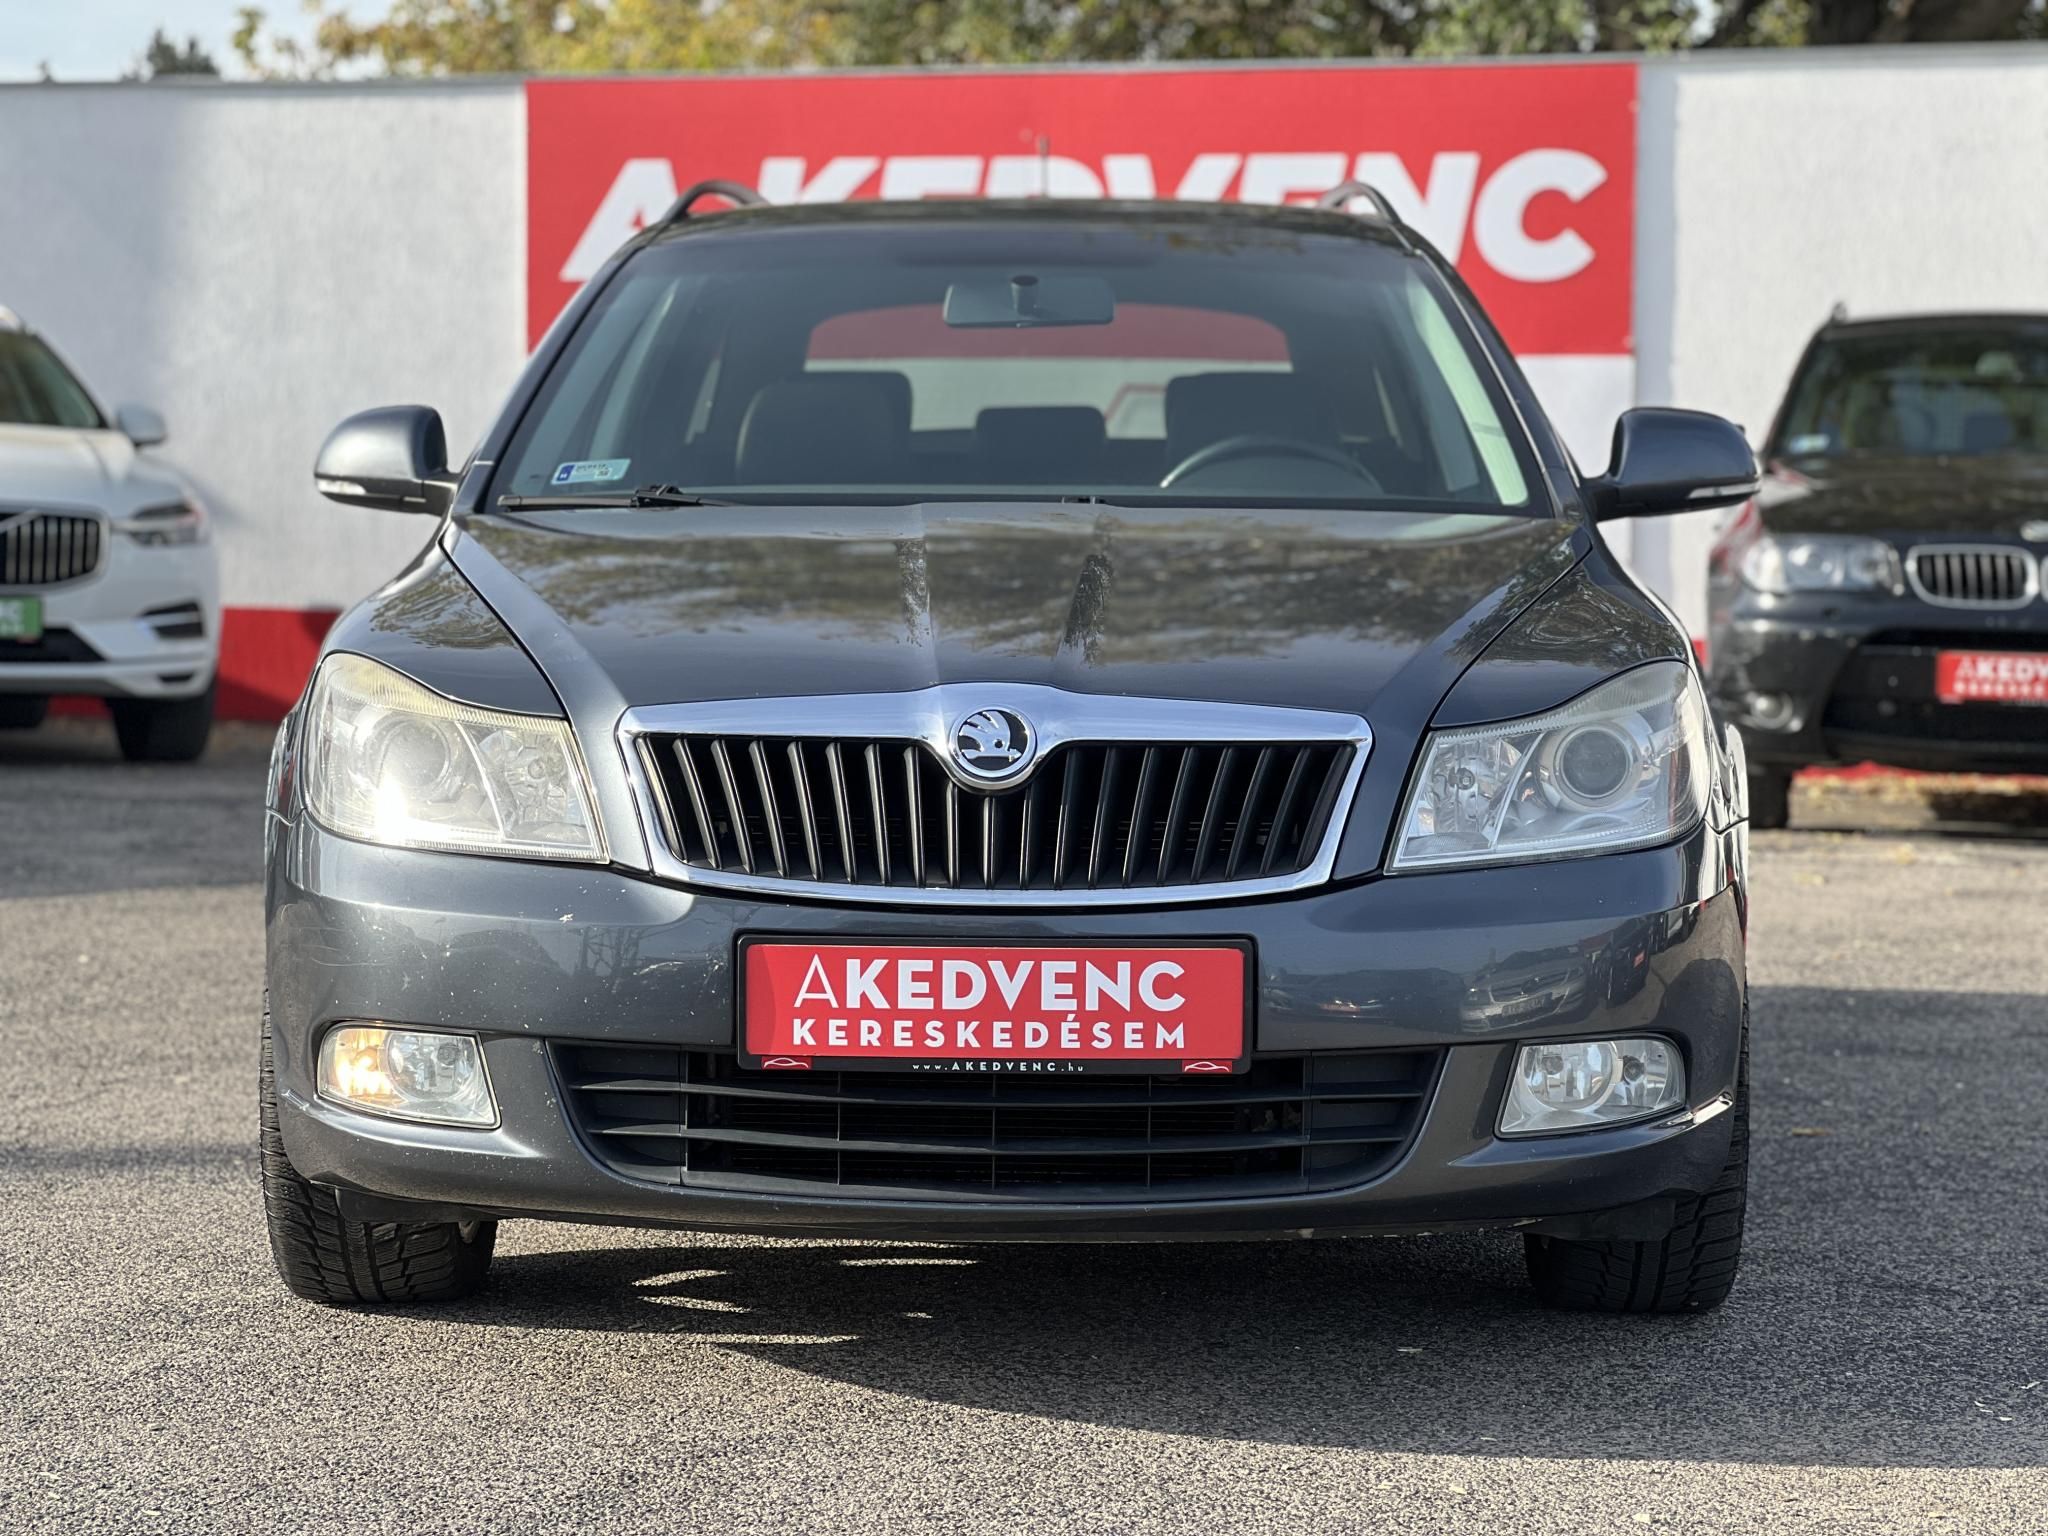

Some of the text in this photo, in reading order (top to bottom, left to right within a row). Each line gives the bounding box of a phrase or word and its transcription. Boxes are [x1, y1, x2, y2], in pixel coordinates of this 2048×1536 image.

[793, 953, 1186, 1012] AKEDVENC
[793, 1013, 1185, 1049] KERESKEDÉSEM
[912, 1061, 1084, 1072] www.AKEDVENC.hu
